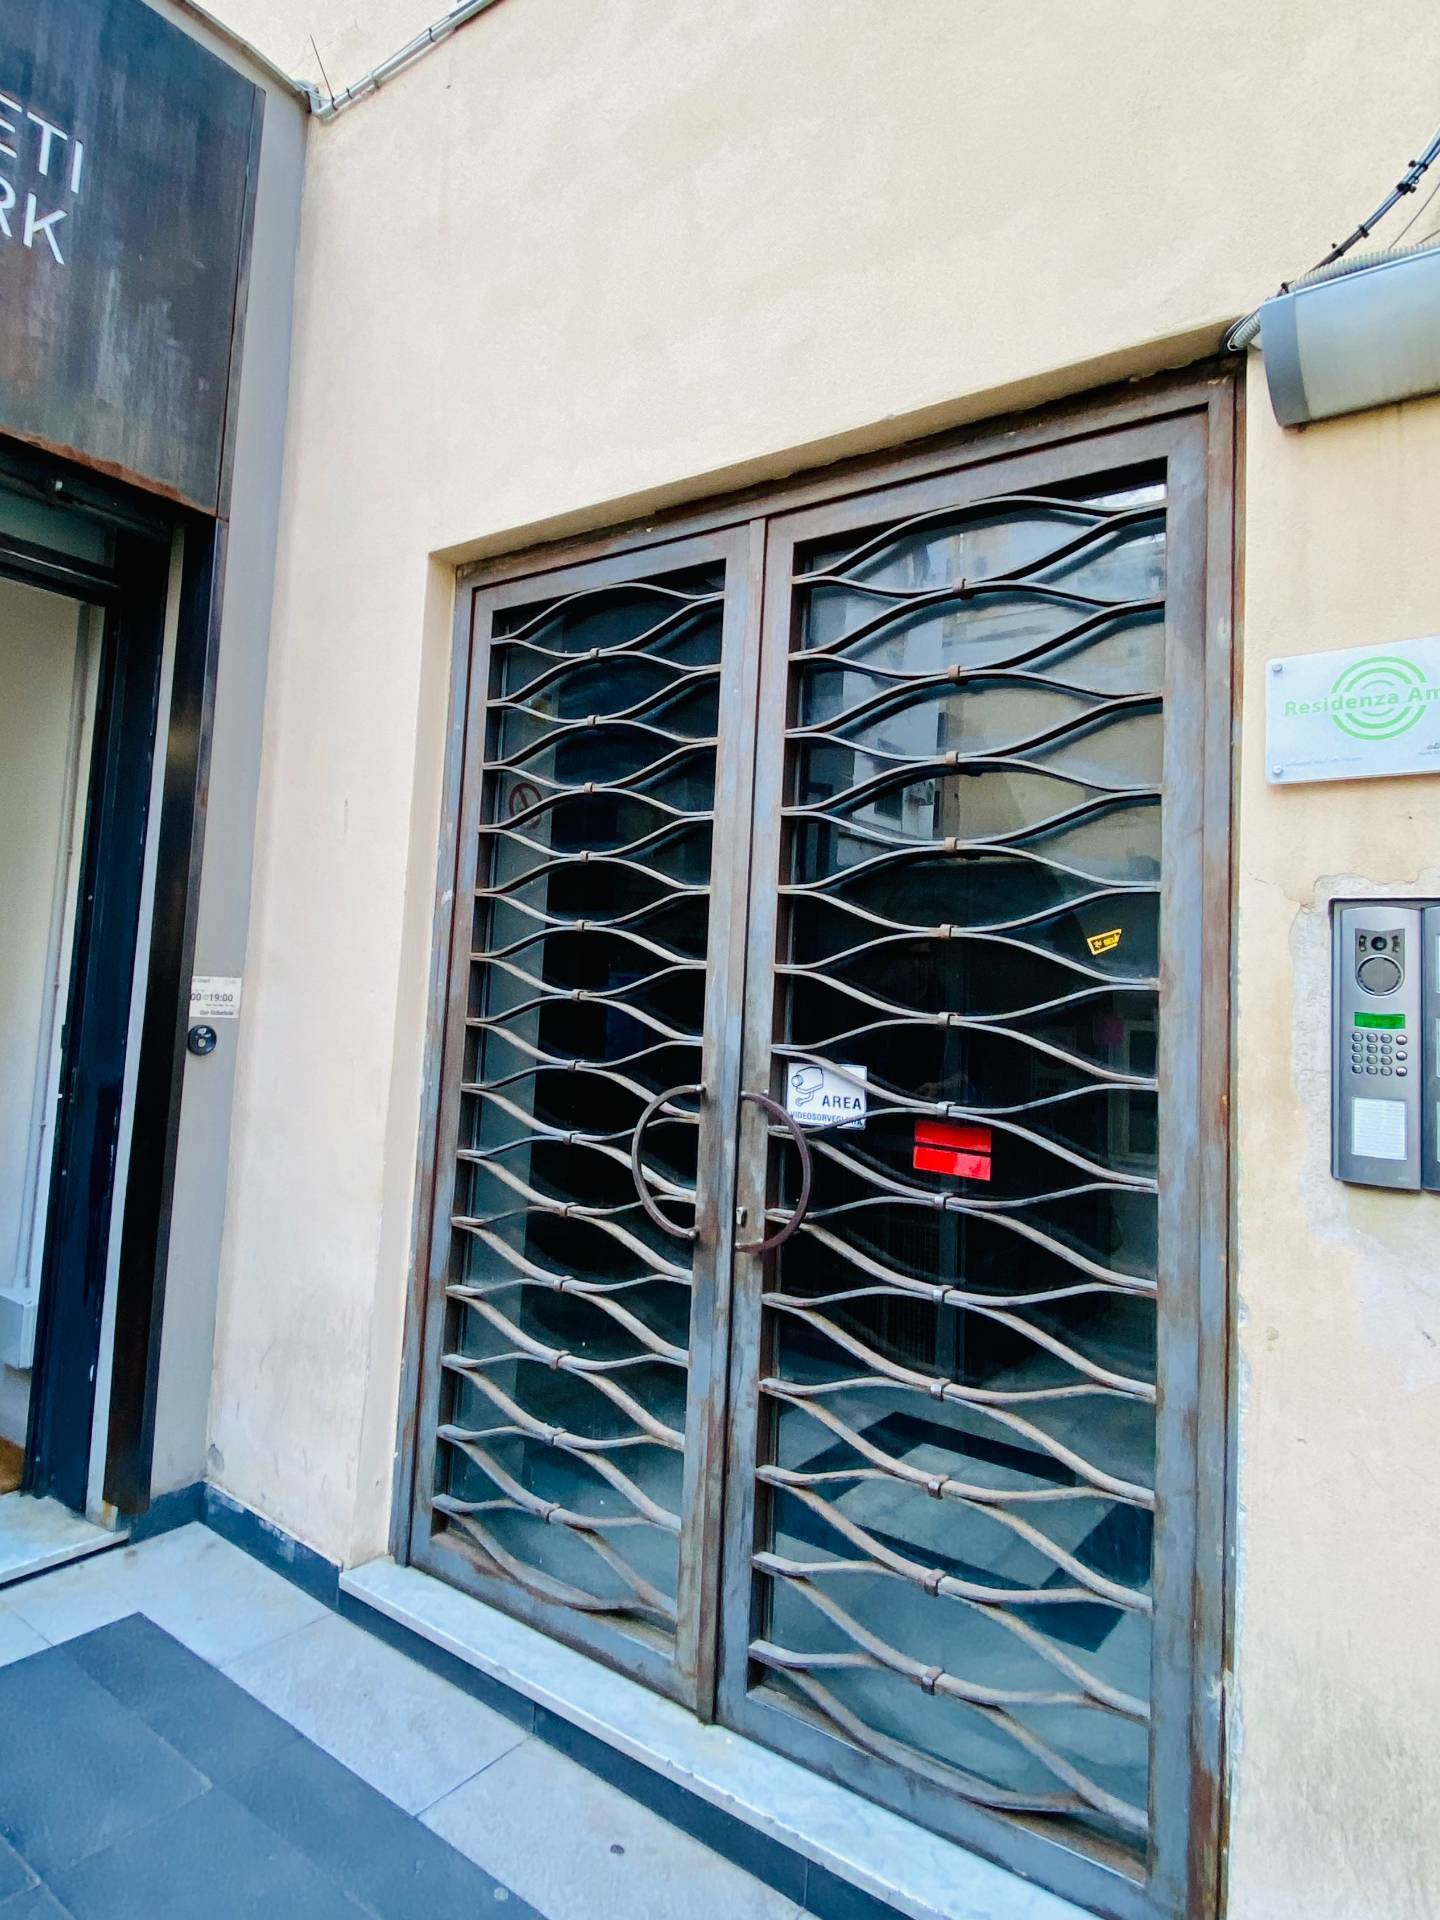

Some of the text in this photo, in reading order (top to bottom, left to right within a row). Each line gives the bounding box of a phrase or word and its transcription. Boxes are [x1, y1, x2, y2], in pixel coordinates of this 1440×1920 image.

[1284, 692, 1400, 716] Residenza
[210, 993, 233, 1002] 19:00
[822, 1095, 861, 1110] AREA
